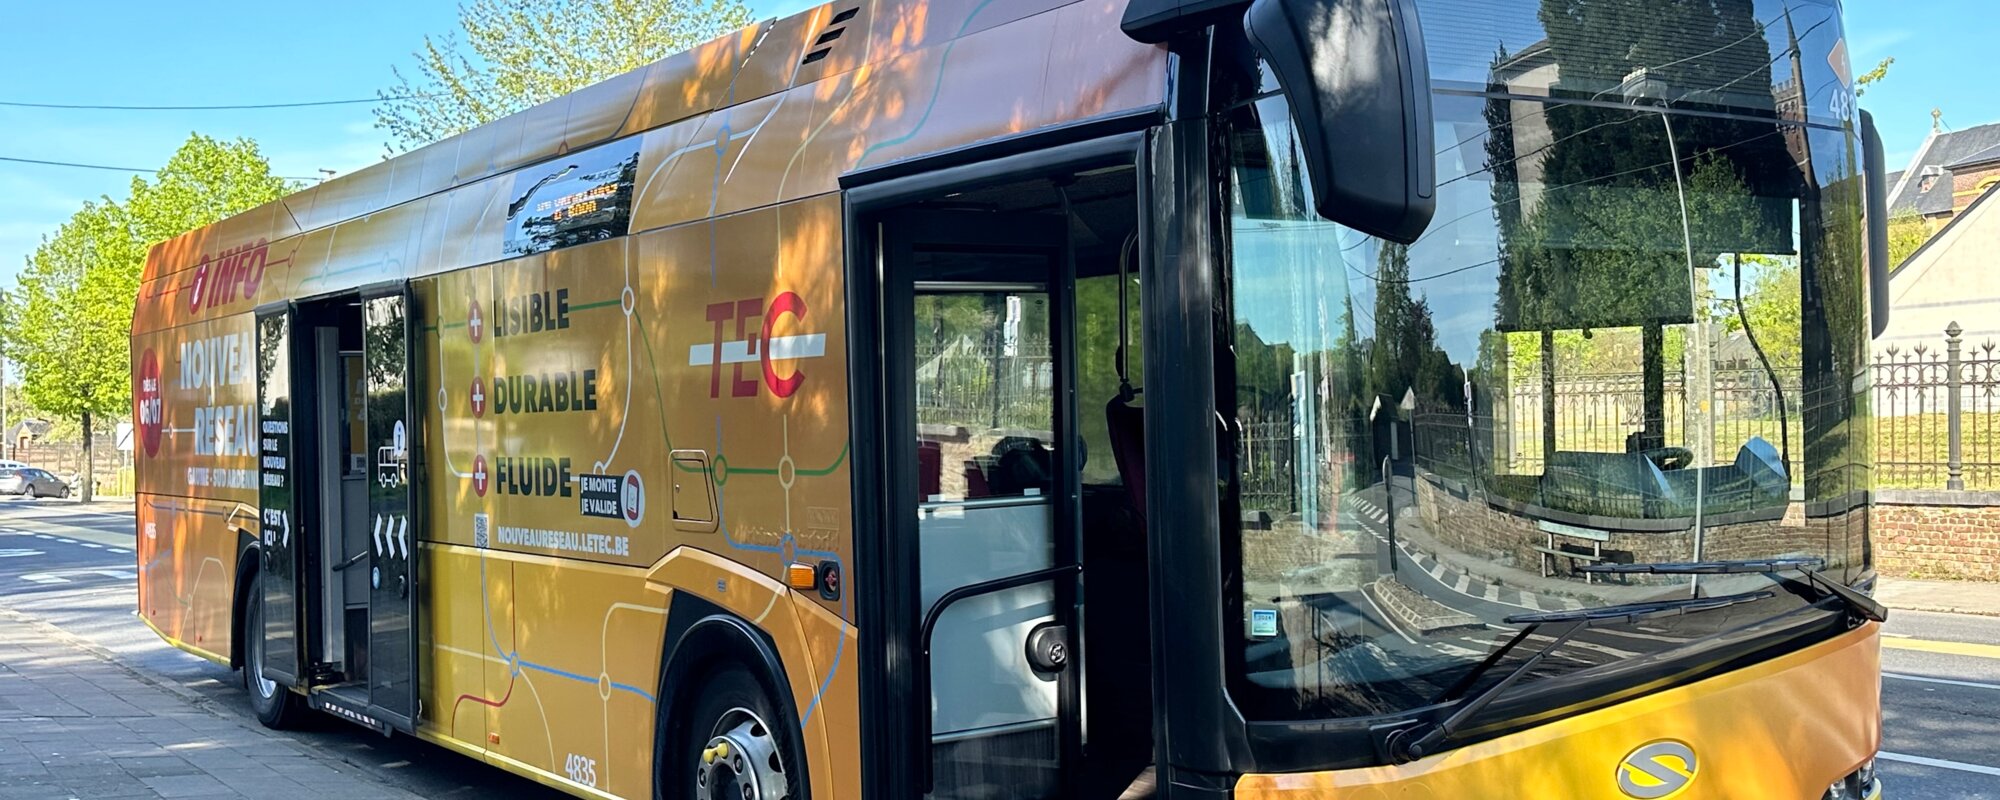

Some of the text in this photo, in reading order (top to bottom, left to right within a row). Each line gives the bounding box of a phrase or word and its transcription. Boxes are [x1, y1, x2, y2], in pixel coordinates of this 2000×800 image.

[1829, 88, 1858, 126] 483
[206, 237, 269, 309] INFO
[493, 288, 570, 338] LISIBLE
[180, 331, 255, 390] NOUVEA
[706, 291, 808, 399] TEC
[493, 369, 598, 414] DURABLE
[139, 396, 161, 427] 06/07
[194, 395, 258, 457] RÉSEAU
[262, 420, 288, 434] QUESTIONS
[213, 468, 227, 488] SUD
[227, 468, 258, 490] ARDENN
[263, 456, 286, 470] NOUVEAU
[496, 457, 572, 497] FLUIDE
[263, 472, 281, 488] RÉSEAU
[580, 477, 617, 494] JE MONTE
[263, 508, 281, 527] C'EST
[581, 498, 617, 516] JE VALIDE
[498, 526, 630, 557] NOUVEAURESEAU.LETEC.BE
[565, 752, 597, 788] 4835
